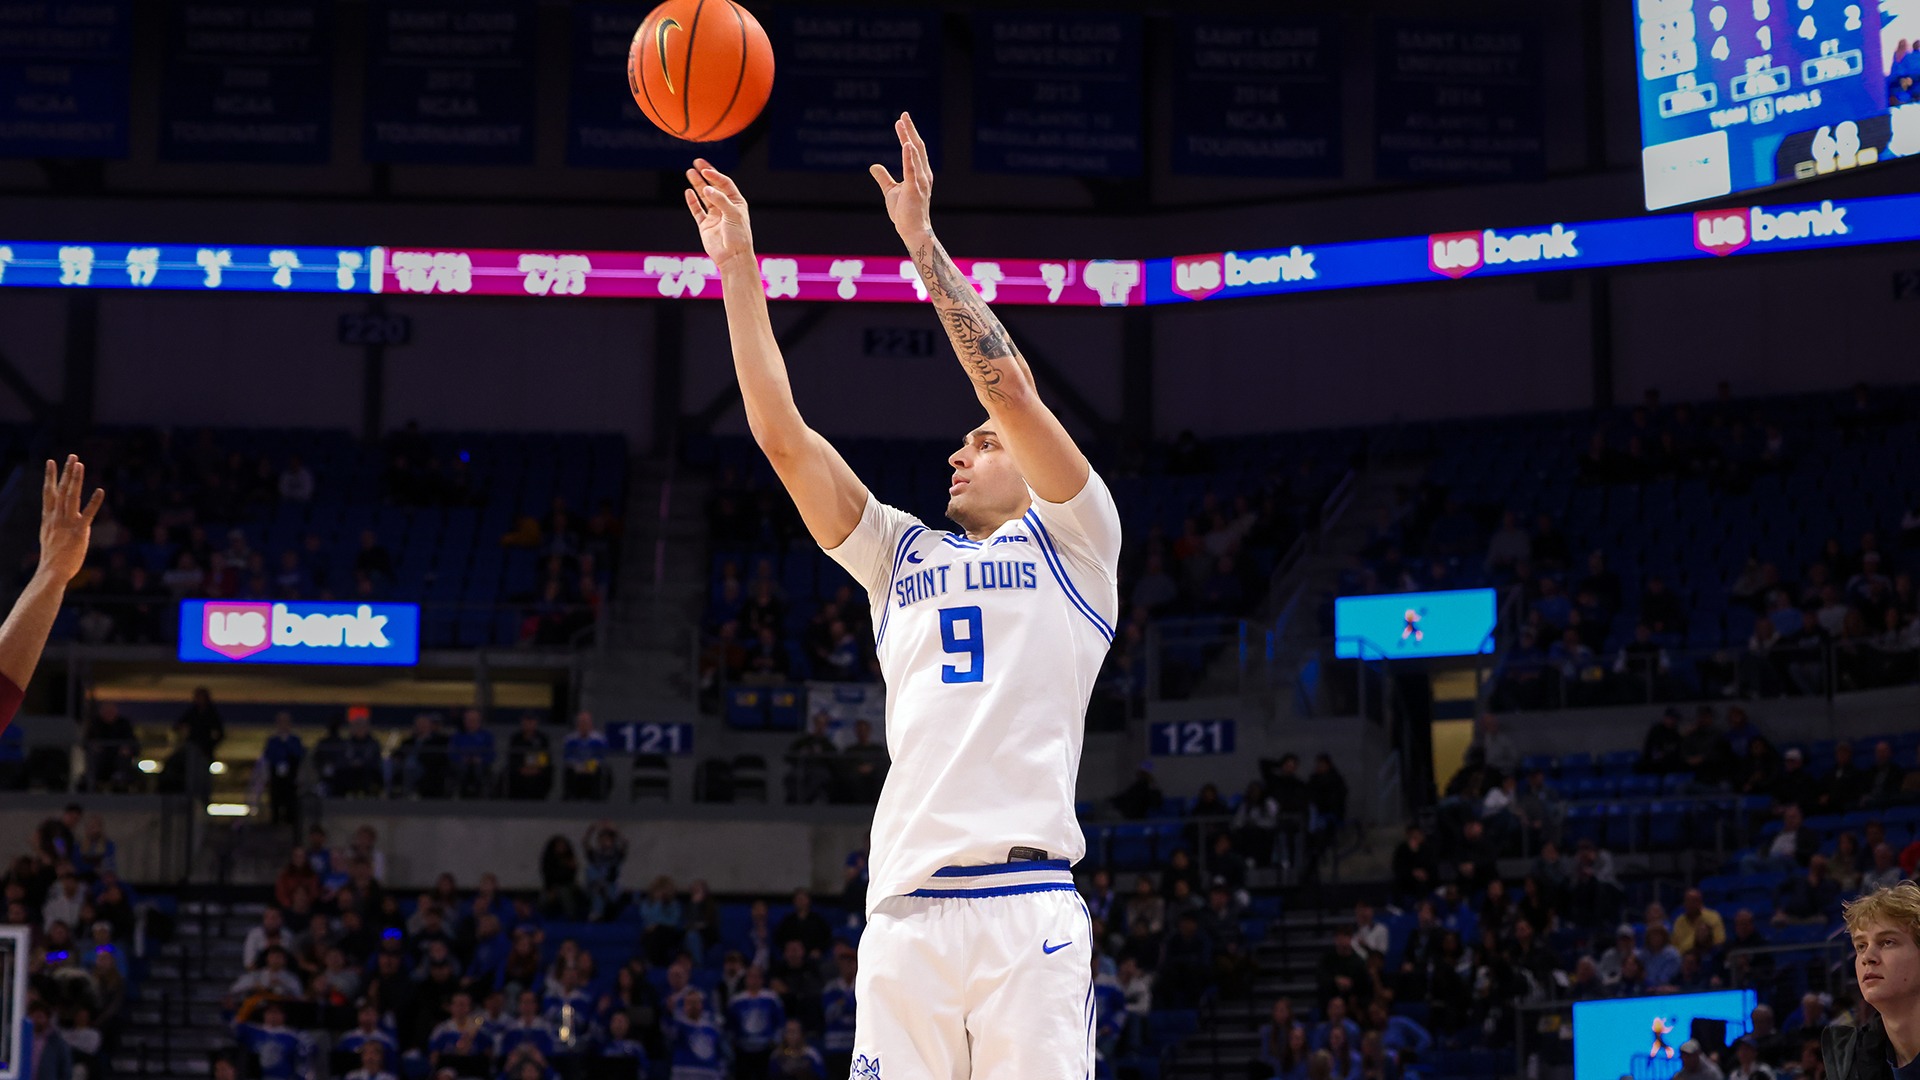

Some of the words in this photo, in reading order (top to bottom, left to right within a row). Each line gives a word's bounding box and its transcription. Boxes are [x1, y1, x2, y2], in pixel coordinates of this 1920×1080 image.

[1811, 120, 1860, 160] 68
[895, 563, 951, 609] SAINT
[963, 561, 1037, 592] LOUIS
[937, 605, 985, 684] 9
[617, 723, 681, 754] 121
[1160, 721, 1223, 754] 121
